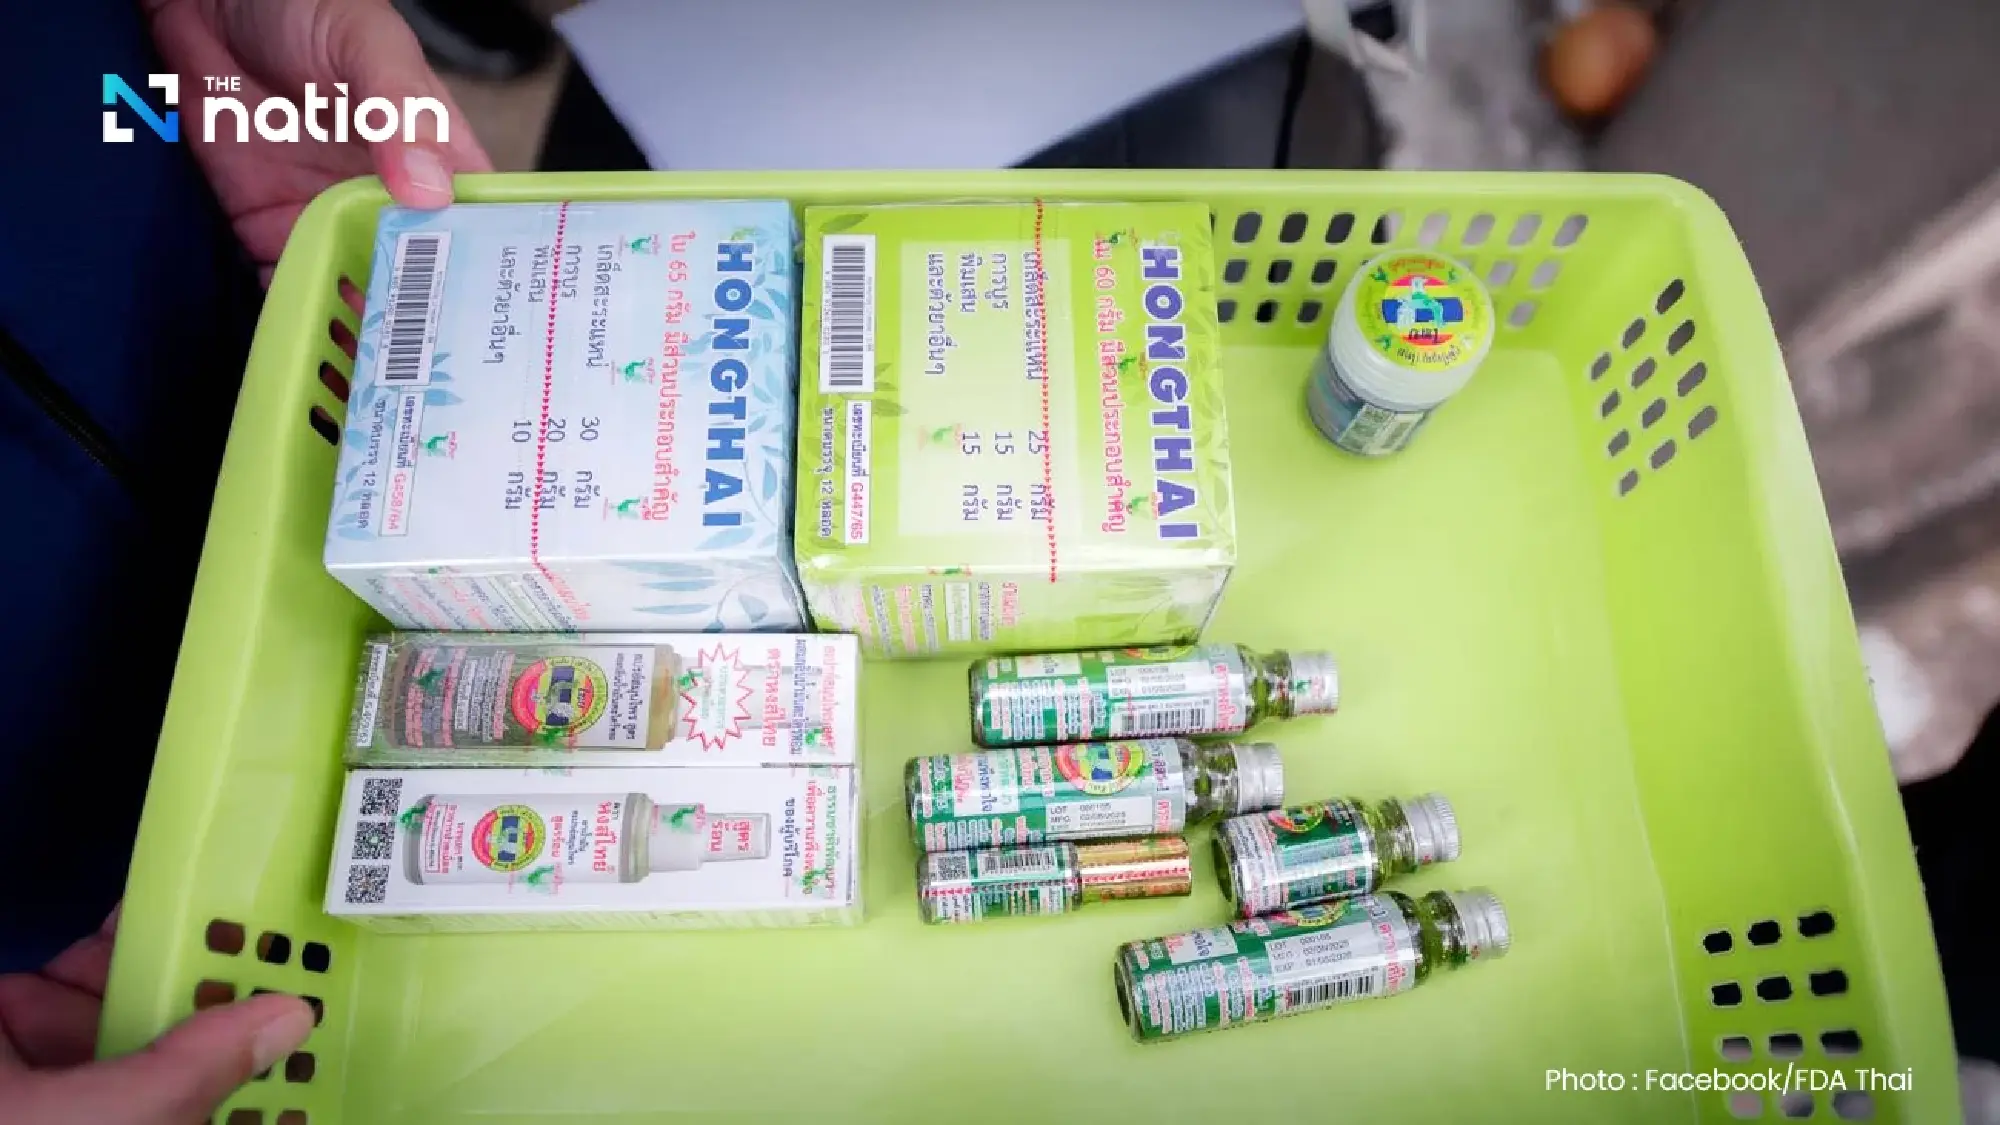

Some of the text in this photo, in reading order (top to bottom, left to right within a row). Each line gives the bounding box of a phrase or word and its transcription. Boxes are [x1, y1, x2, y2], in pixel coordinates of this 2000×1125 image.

[668, 259, 688, 283] 65
[1096, 267, 1116, 290] 60
[665, 289, 691, 325] กรัม
[1096, 296, 1124, 333] กรัม
[702, 242, 755, 527] HONGTHAI
[959, 252, 987, 521] พิมเสน 15 กรัม
[986, 252, 1021, 521] การบูร 15 กรัม
[1141, 246, 1199, 538] HONGTHAI
[512, 419, 532, 443] 10
[546, 417, 567, 442] 20
[579, 416, 600, 441] 30
[1029, 430, 1050, 455] 25
[365, 471, 376, 487] 12
[504, 471, 530, 510] กรัม
[538, 470, 567, 510] กรัม
[573, 470, 600, 509] กรัม
[821, 479, 833, 495] 12
[1050, 805, 1068, 815] LOT
[1050, 815, 1071, 823] MFG
